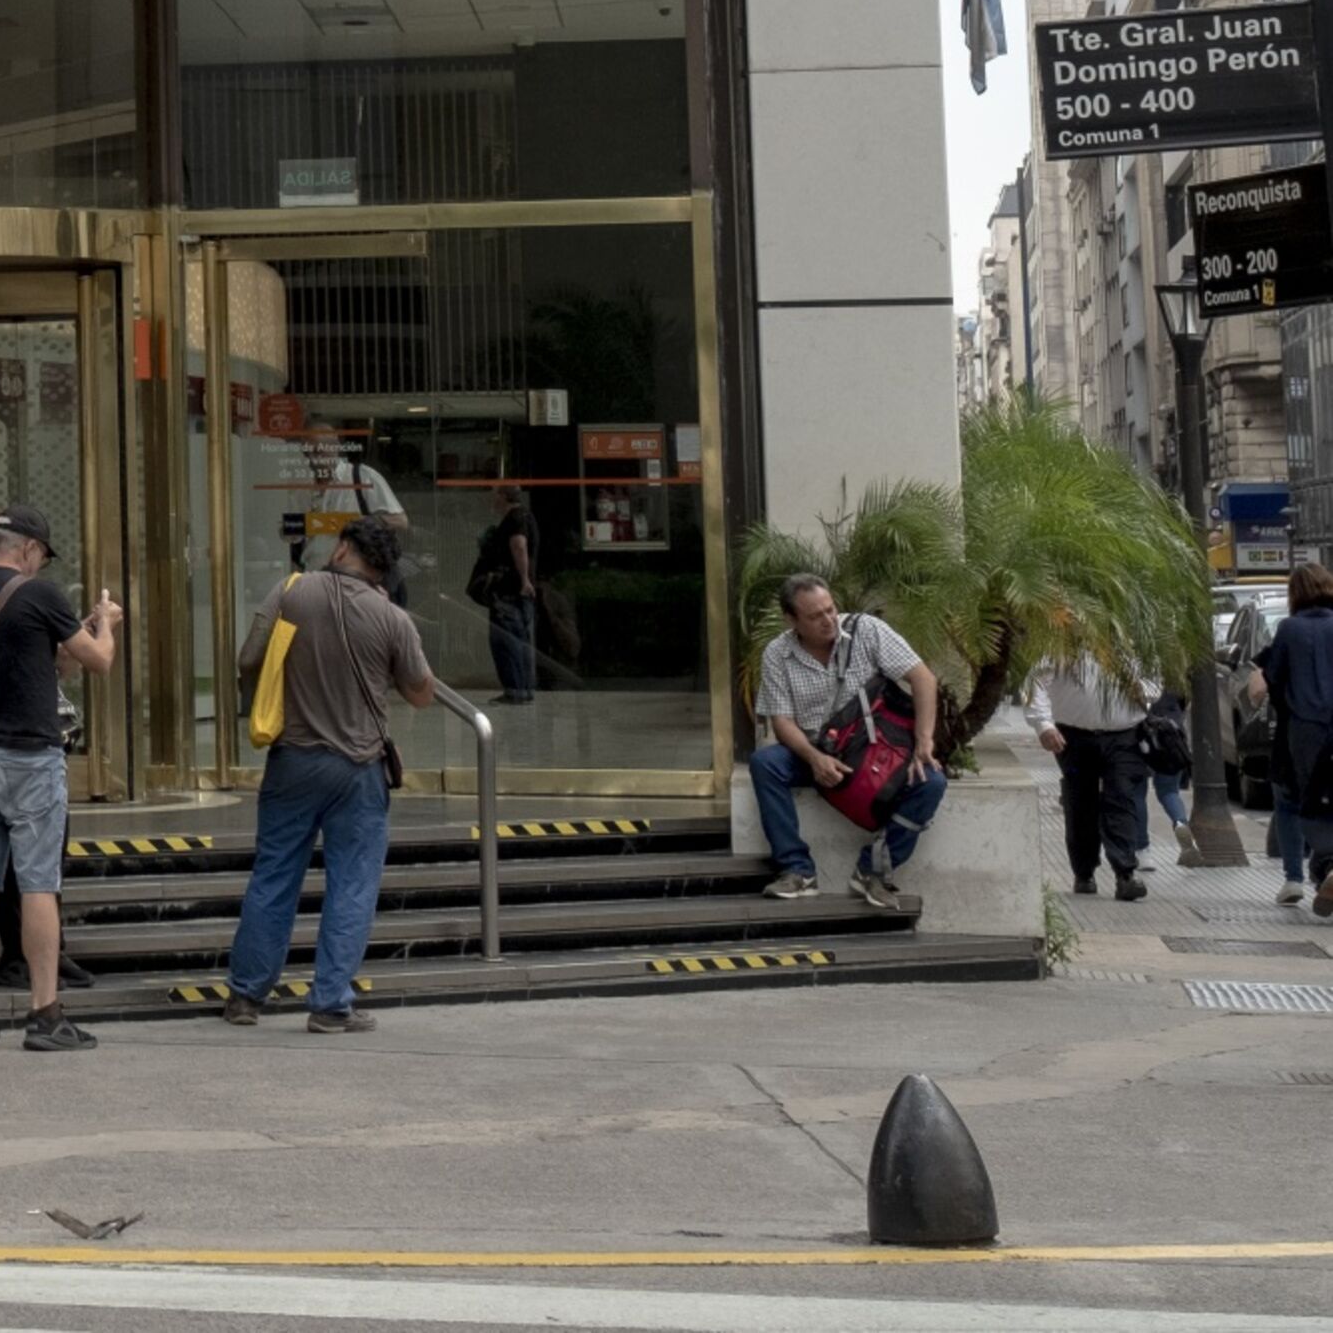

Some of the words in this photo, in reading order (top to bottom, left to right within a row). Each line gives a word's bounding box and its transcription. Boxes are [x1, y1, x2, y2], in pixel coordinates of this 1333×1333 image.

[1048, 28, 1111, 53] Tte.
[1119, 19, 1194, 47] Gral.
[1204, 15, 1283, 41] Juan
[1053, 55, 1198, 86] Domingo
[1207, 43, 1300, 73] Perón
[1055, 93, 1111, 121] 500
[1120, 102, 1132, 110] -
[1139, 86, 1196, 113] 400
[1057, 126, 1143, 148] Comuna
[1149, 123, 1160, 139] 1
[1194, 179, 1302, 216] Reconquista
[1201, 254, 1232, 281] 300
[1246, 248, 1279, 275] 200
[1203, 288, 1250, 306] Comuna
[1252, 283, 1260, 301] 1
[317, 469, 330, 479] 15
